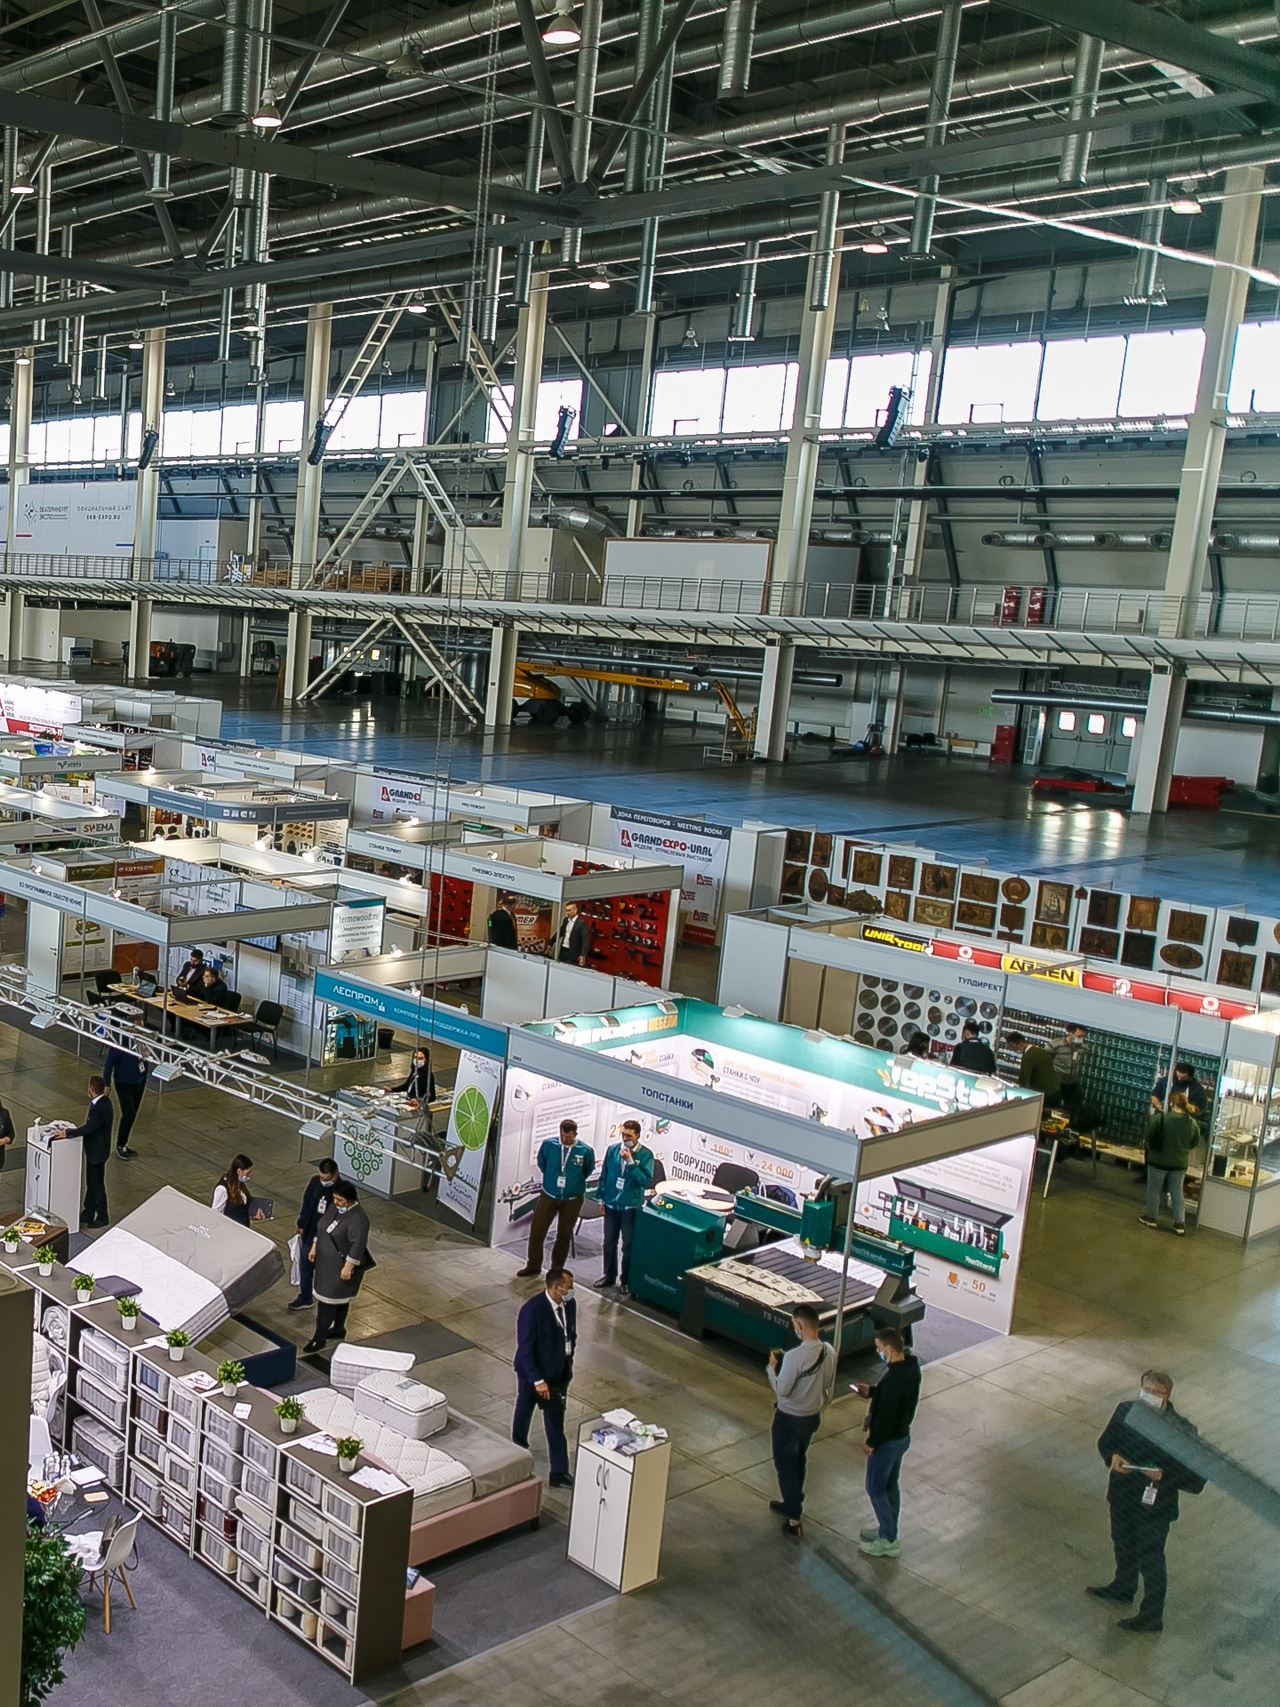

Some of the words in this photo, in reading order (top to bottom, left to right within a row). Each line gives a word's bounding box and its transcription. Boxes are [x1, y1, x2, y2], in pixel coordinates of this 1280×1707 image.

[83, 823, 114, 833] SWEMA
[633, 812, 671, 826] ПЕРЕГОВОРОВ
[677, 822, 702, 832] MEETING
[703, 827, 723, 836] ROOM
[634, 843, 653, 851] НЕДЕЛЯ
[654, 846, 686, 858] ОТРАСЛЕВЫХ
[686, 853, 713, 862] ВЫСТАВОК
[472, 866, 516, 881] ПНЕВМО-ЭЛЕКТРО
[958, 976, 1003, 992] ТУЛДИРЕКТ
[332, 985, 379, 1005] ЛЕСПРОМ
[722, 1066, 744, 1079] СТАНКИ
[641, 1086, 694, 1110] ТОПСТАНКИ
[673, 1150, 717, 1176] ОБОРУДОВ
[761, 1160, 773, 1172] 24
[775, 1166, 794, 1180] 000
[671, 1165, 711, 1185] ПОЛНОГО
[971, 1279, 986, 1293] 50
